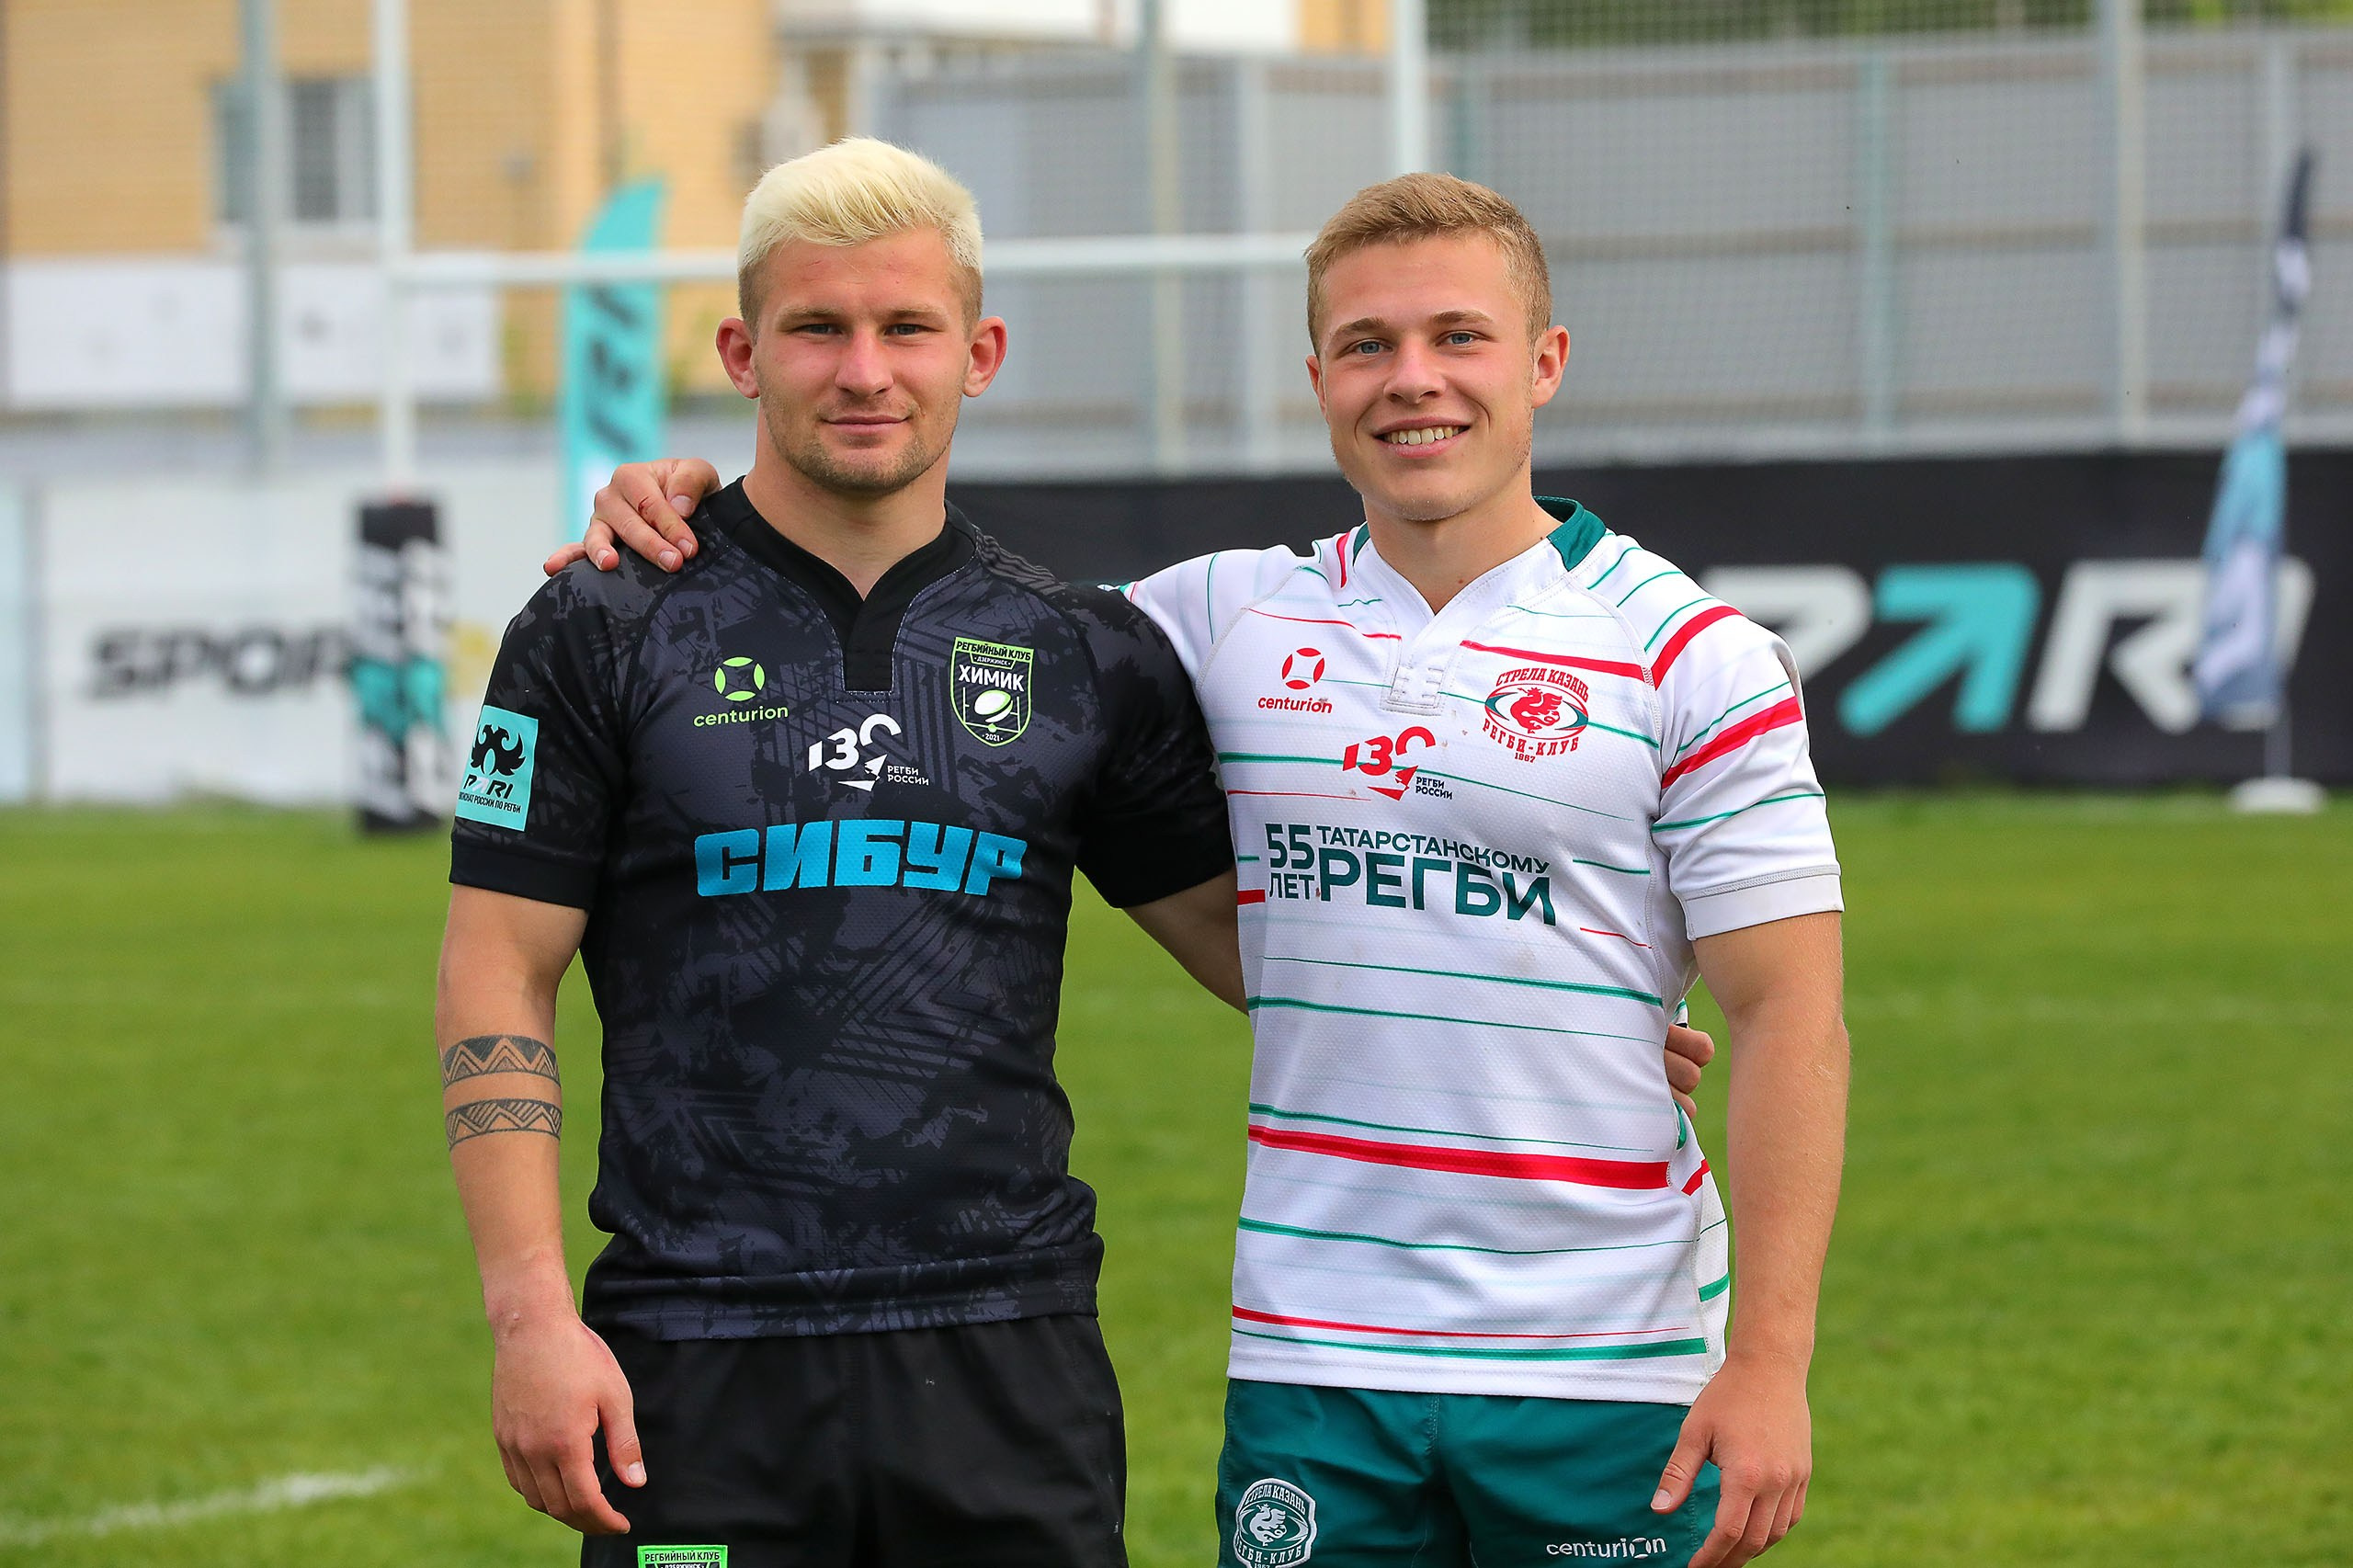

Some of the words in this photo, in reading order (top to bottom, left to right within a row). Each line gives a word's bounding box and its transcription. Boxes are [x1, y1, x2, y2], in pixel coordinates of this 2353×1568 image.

[956, 642, 1007, 657] РЕГБИЙНЫЙ
[1007, 649, 1031, 661] КЛУБ
[958, 664, 1025, 692] ХИМИК
[1495, 668, 1548, 687] СТРЕЛА
[1547, 669, 1588, 703] КАЗАНЬ
[693, 705, 789, 728] centurion
[1257, 697, 1333, 715] centurion
[985, 733, 1000, 742] 2021
[1482, 718, 1579, 756] РЕГБИ-КЛУБ
[887, 765, 919, 776] РЕГБИ
[887, 774, 929, 786] РОССИИ
[463, 774, 514, 800] PARI
[1415, 777, 1445, 789] РЕГБИ
[1415, 786, 1453, 800] РОССИИ
[474, 795, 495, 807] РОССИИ
[494, 800, 504, 809] ПО
[504, 801, 522, 814] РЕГБИ
[1265, 823, 1315, 869] 55
[1316, 825, 1550, 874] ТАТАРСТАНСКОМУ
[694, 819, 1028, 897] СИБУР
[1268, 872, 1315, 900] ЛЕТ
[1319, 847, 1557, 926] РЕГБИ
[1272, 1485, 1306, 1516] КАЗАНЬ
[645, 1551, 696, 1562] РЕГБИЙНЫЙ
[697, 1551, 720, 1561] КЛУБ
[1546, 1537, 1667, 1560] centurion
